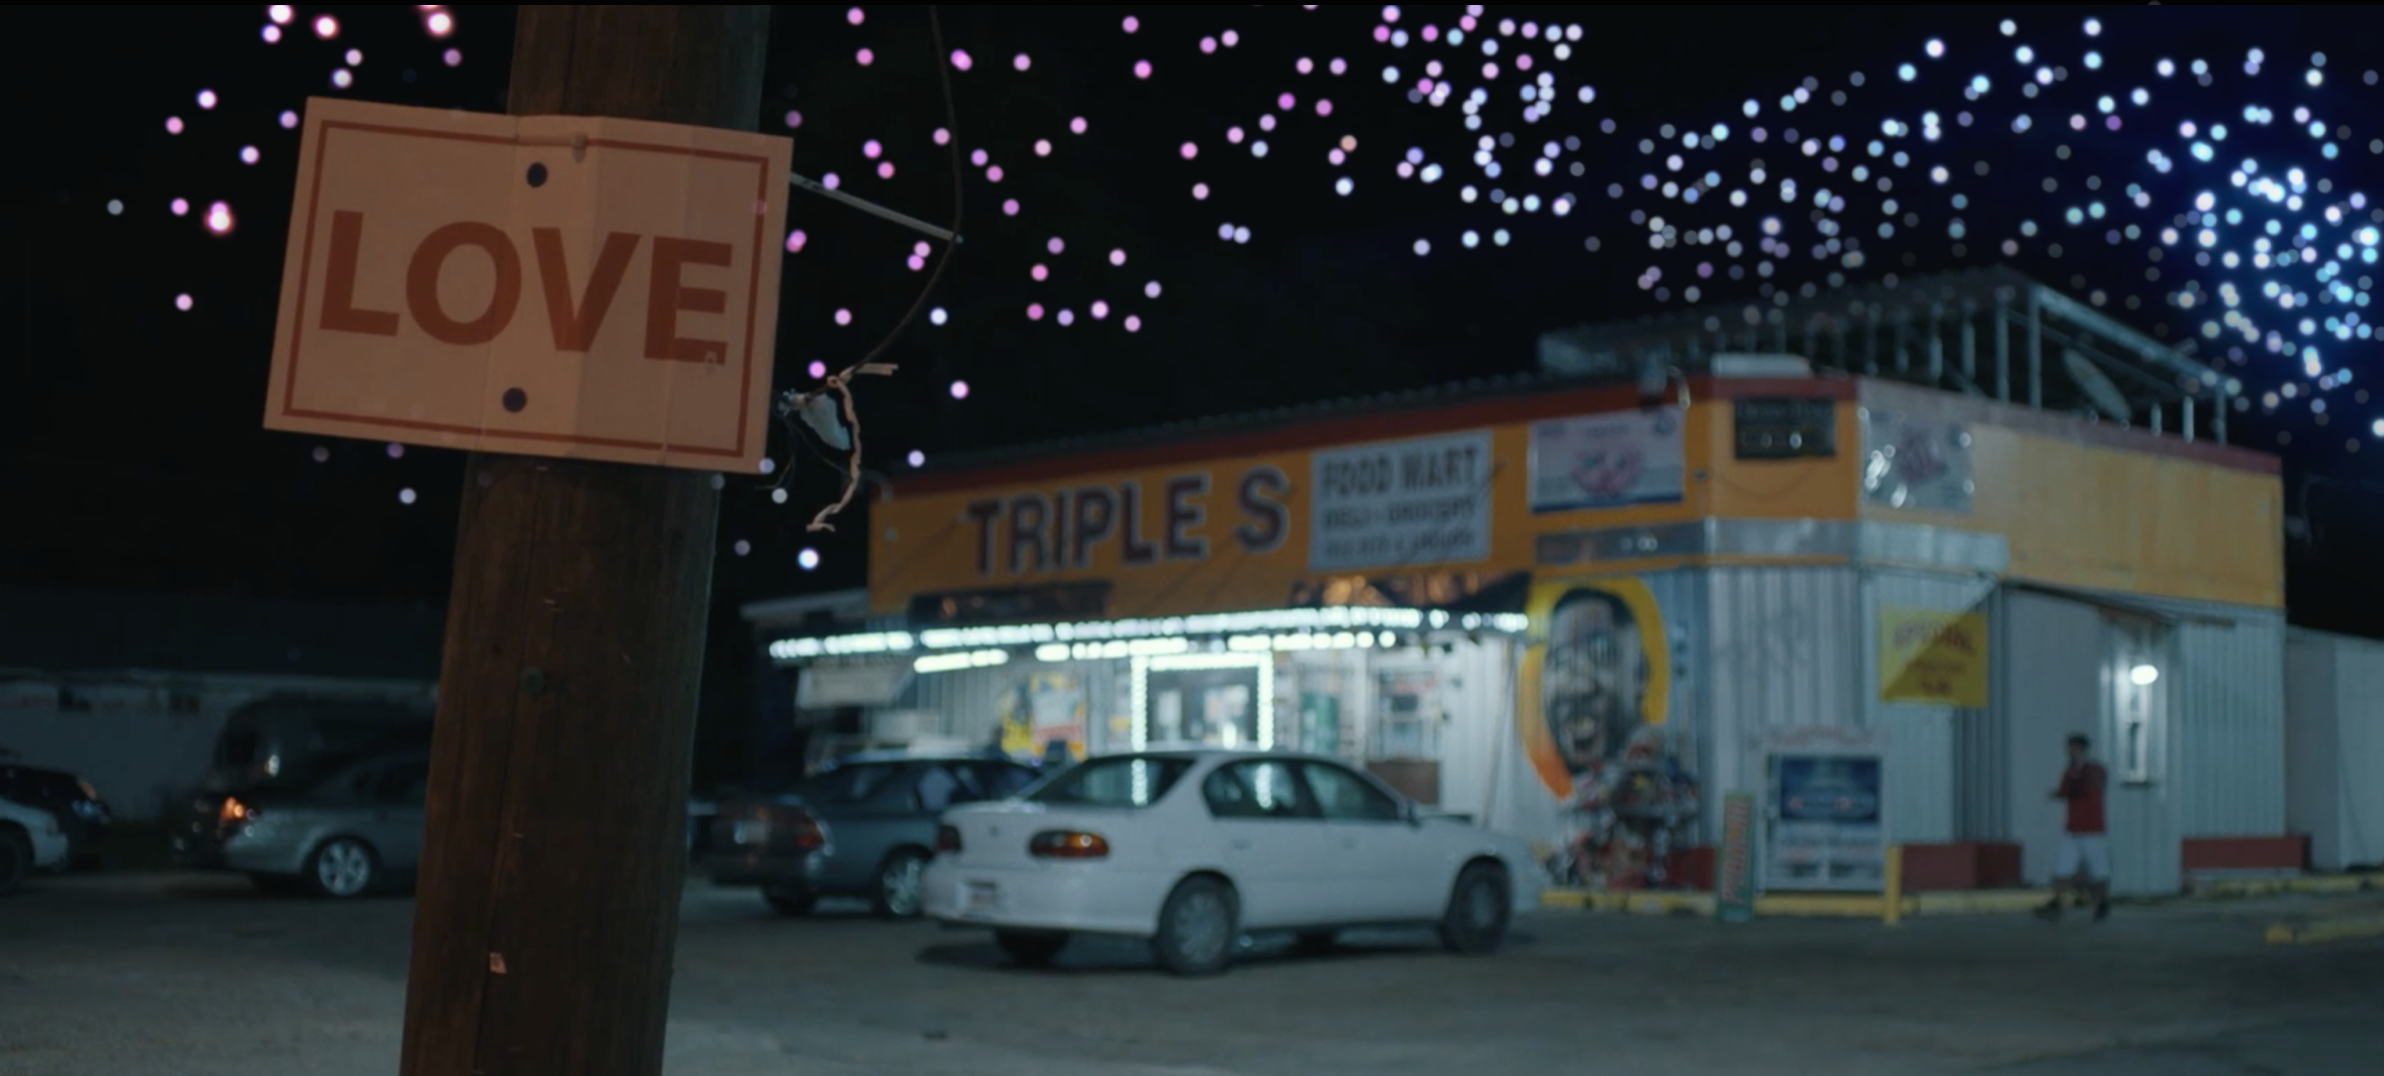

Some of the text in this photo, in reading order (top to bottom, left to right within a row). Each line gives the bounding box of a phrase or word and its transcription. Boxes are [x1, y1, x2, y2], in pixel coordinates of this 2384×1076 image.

[319, 209, 733, 365] LOVE
[966, 465, 1292, 577] TRIPLE S
[1321, 446, 1479, 496] FOOD MART
